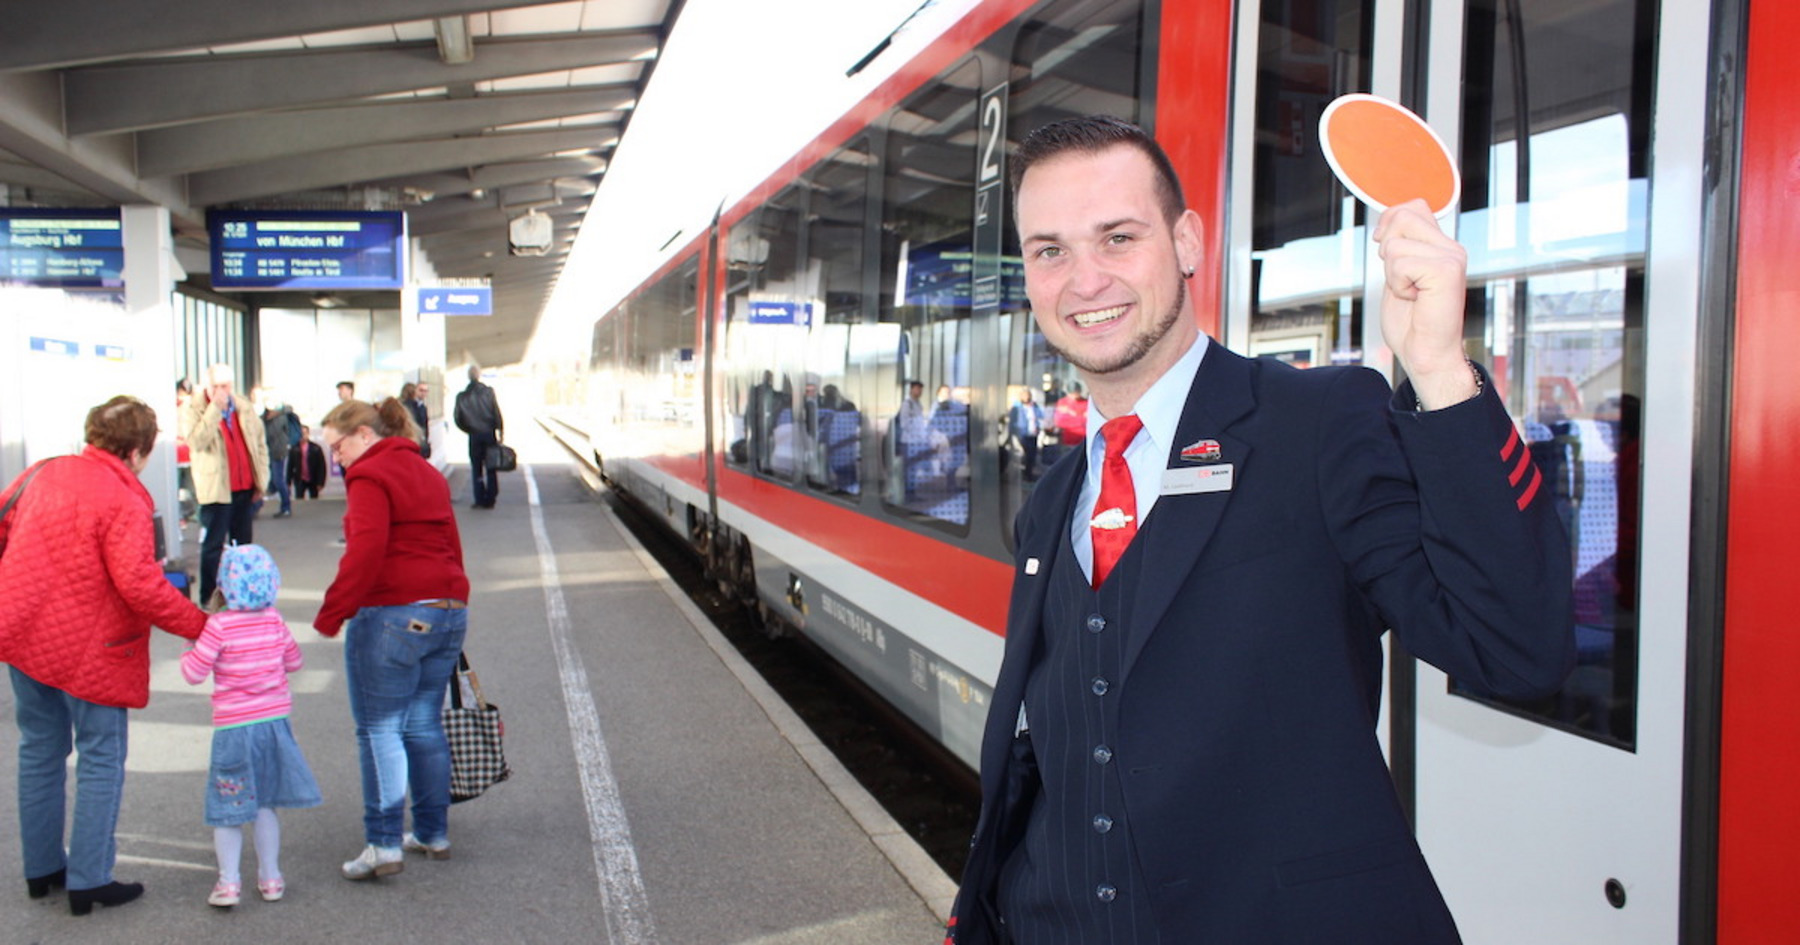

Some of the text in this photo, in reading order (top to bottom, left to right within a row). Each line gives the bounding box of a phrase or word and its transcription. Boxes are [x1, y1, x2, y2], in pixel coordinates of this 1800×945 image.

[980, 96, 1001, 183] 2
[10, 234, 82, 248] Augsburg Hbf
[256, 234, 344, 247] von München Hbf
